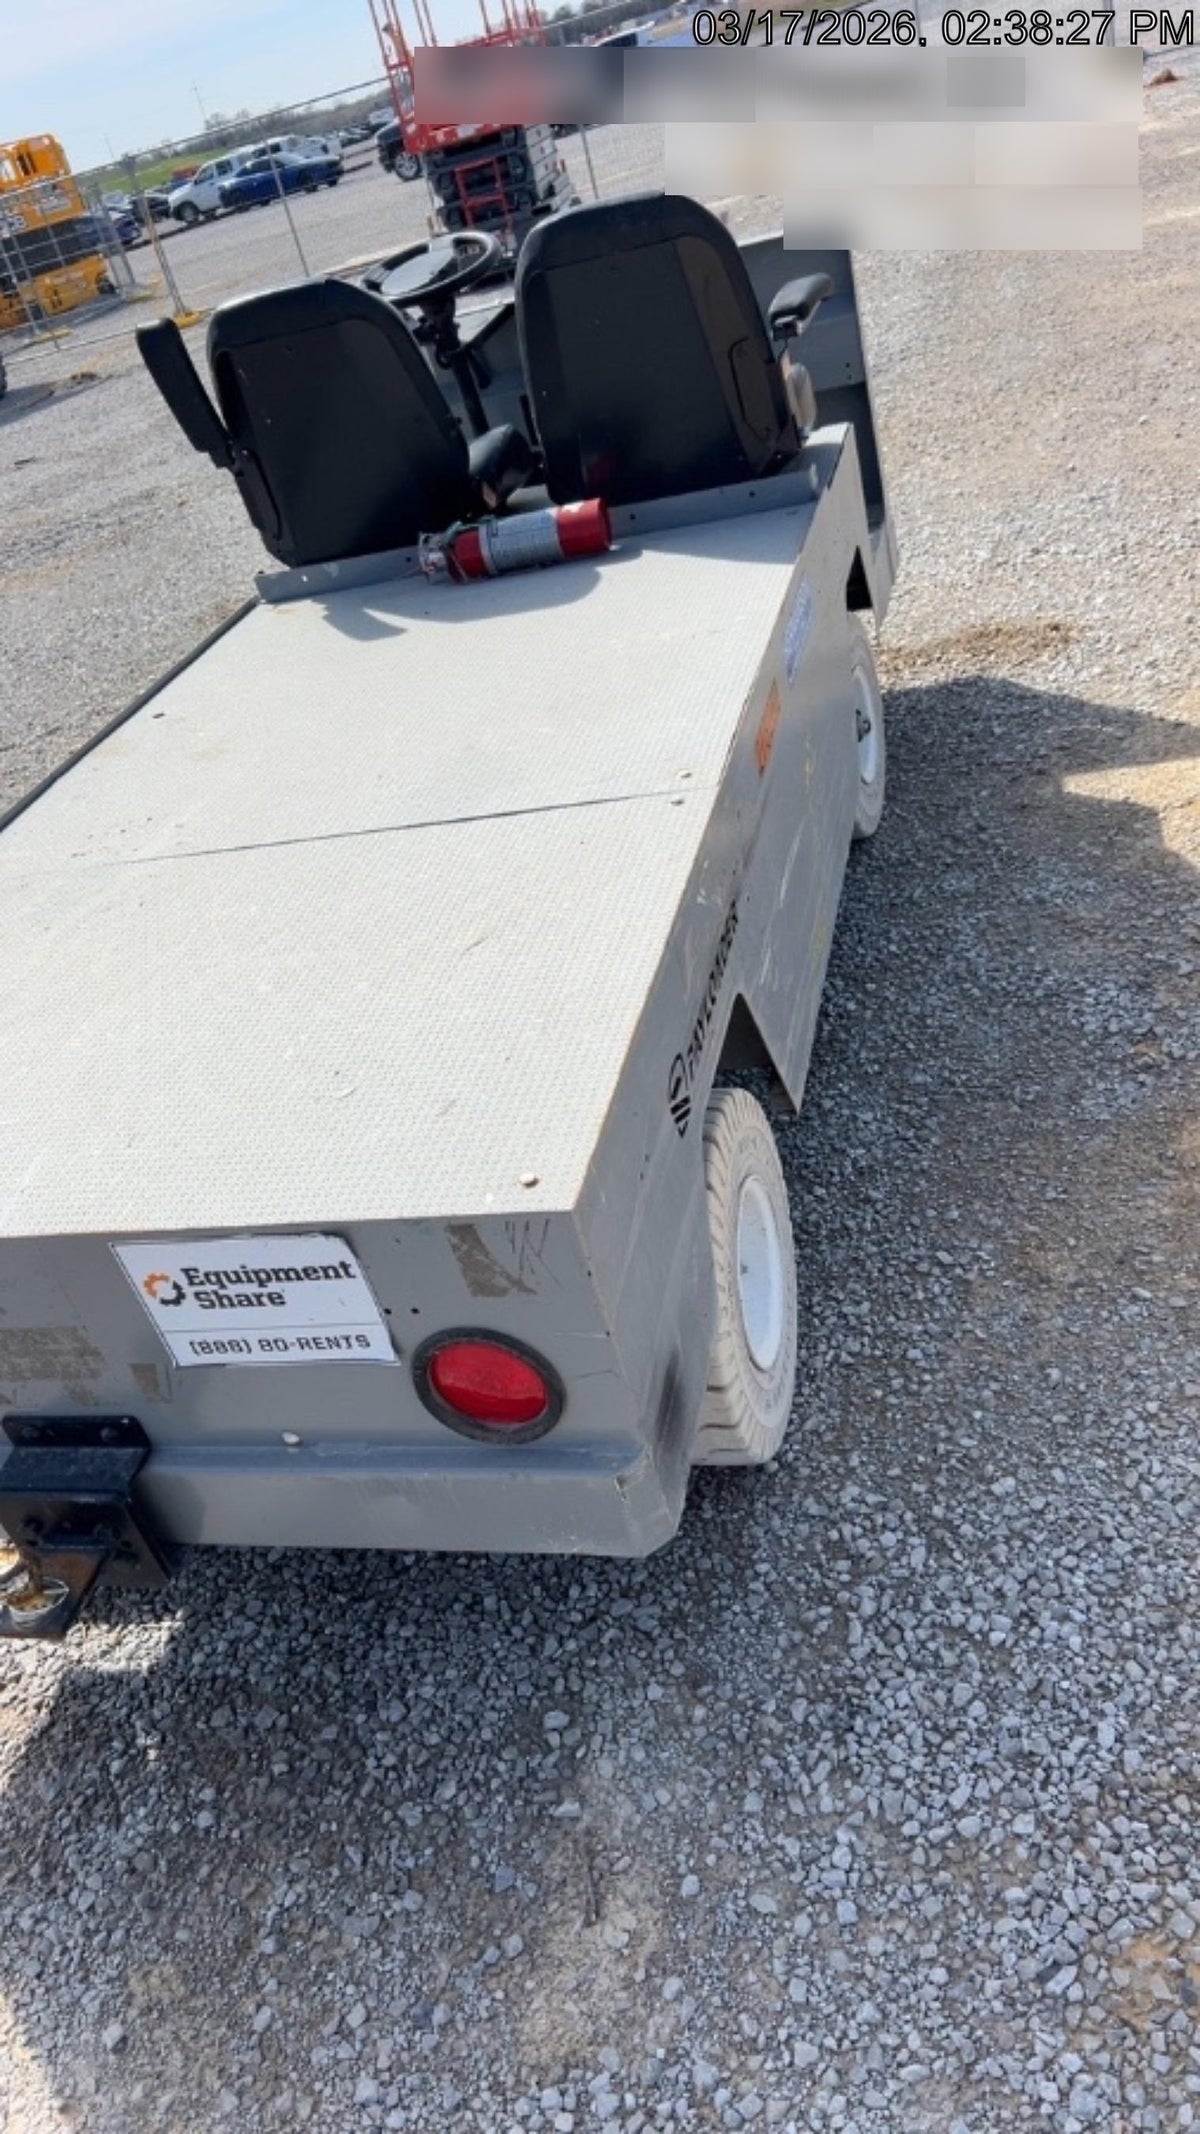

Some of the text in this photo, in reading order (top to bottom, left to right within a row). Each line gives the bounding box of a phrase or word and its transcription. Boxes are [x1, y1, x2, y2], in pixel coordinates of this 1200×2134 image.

[180, 1260, 356, 1290] Equipment
[194, 1289, 287, 1310] Share
[189, 1334, 371, 1356] (888) 80-RENTS
